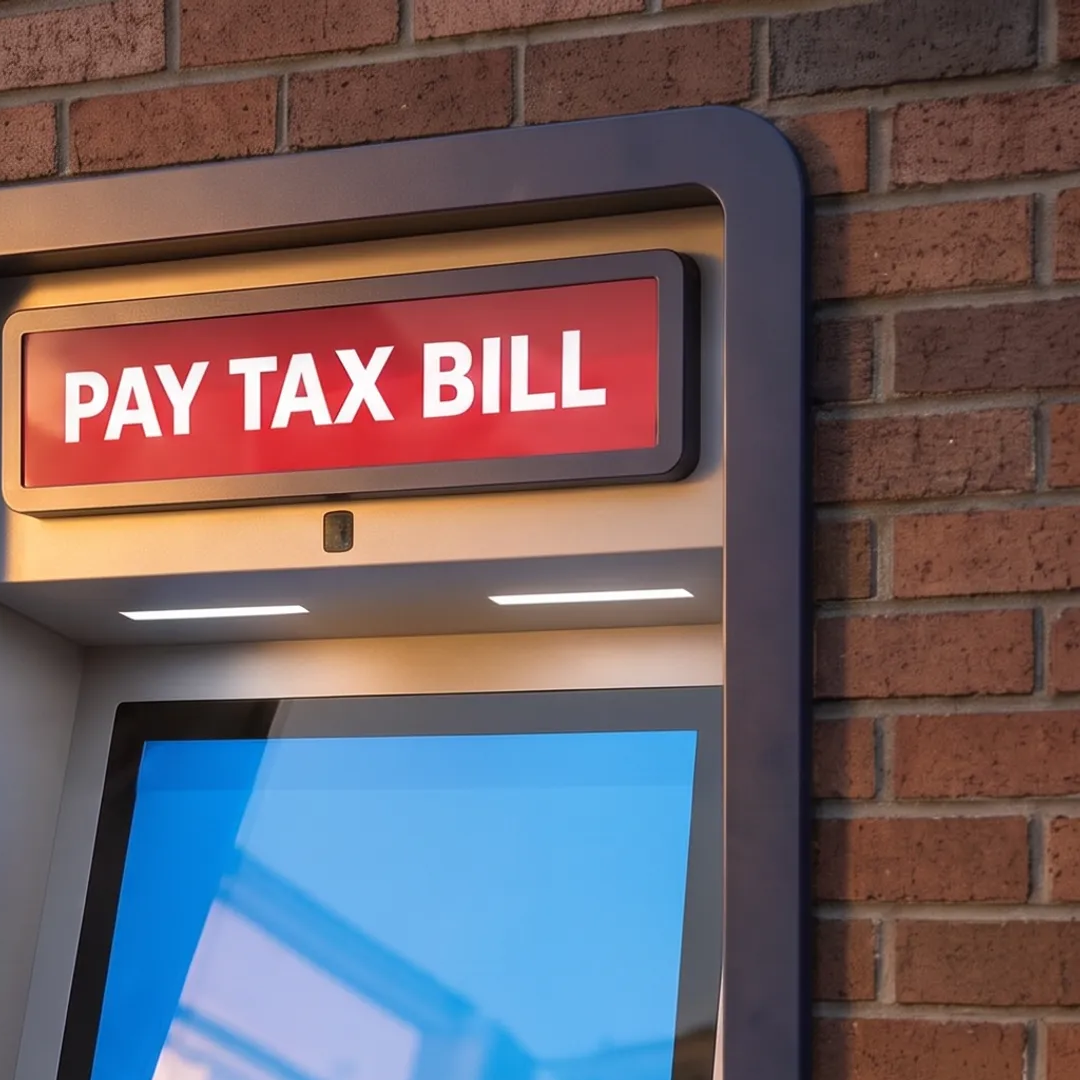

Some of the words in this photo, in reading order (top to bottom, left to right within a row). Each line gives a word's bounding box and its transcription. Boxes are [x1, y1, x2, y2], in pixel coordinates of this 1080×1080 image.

[64, 361, 210, 443] PAY
[228, 345, 395, 432] TAX
[422, 330, 607, 418] BILL
